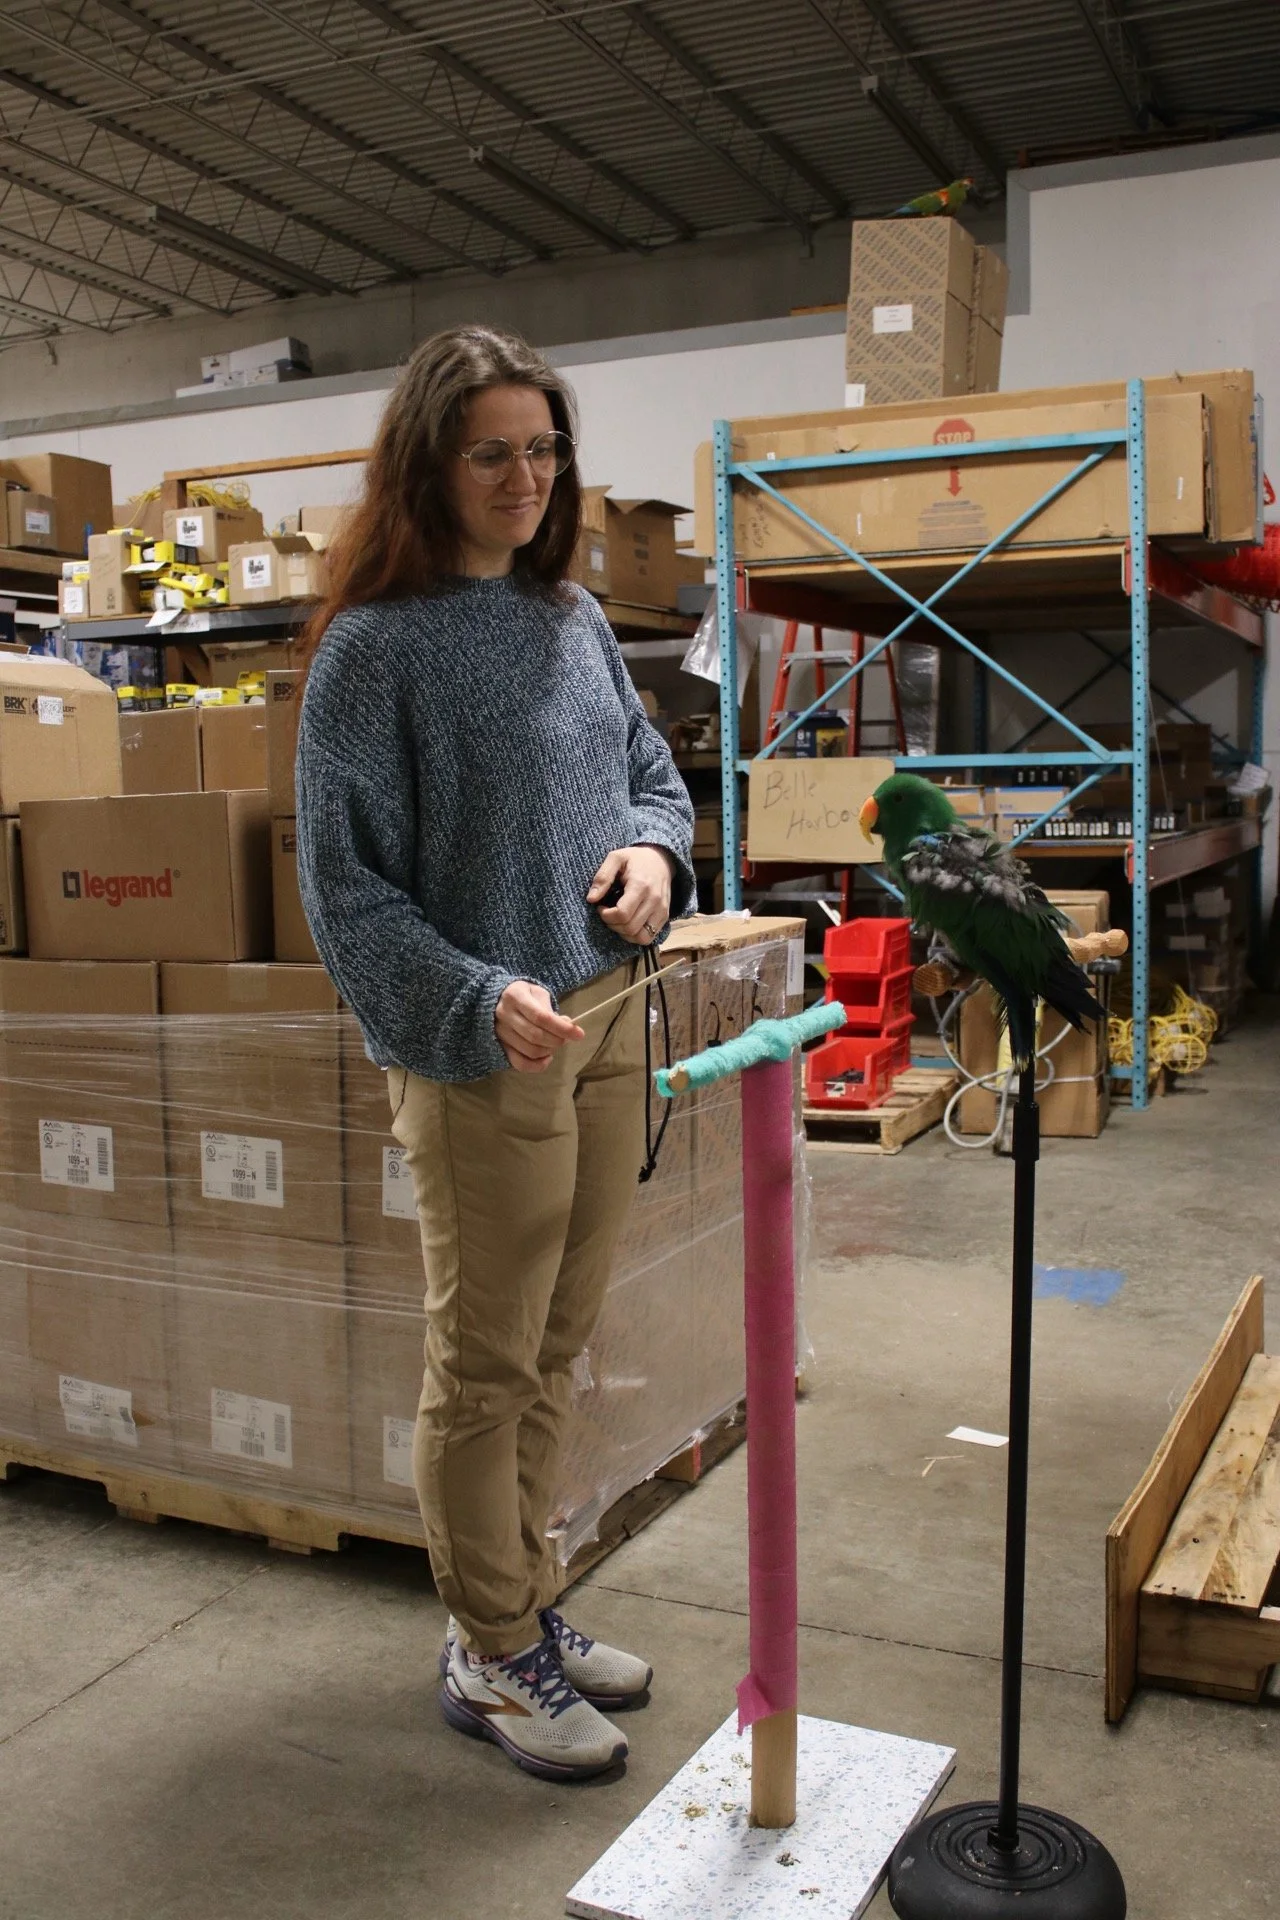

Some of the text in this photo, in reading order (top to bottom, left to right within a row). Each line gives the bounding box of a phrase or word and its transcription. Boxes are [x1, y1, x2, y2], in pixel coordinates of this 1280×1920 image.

[937, 431, 972, 445] STOP
[4, 696, 25, 710] BRK
[763, 770, 816, 809] Belle
[83, 868, 172, 907] legrand
[232, 1169, 256, 1180] 1099-N
